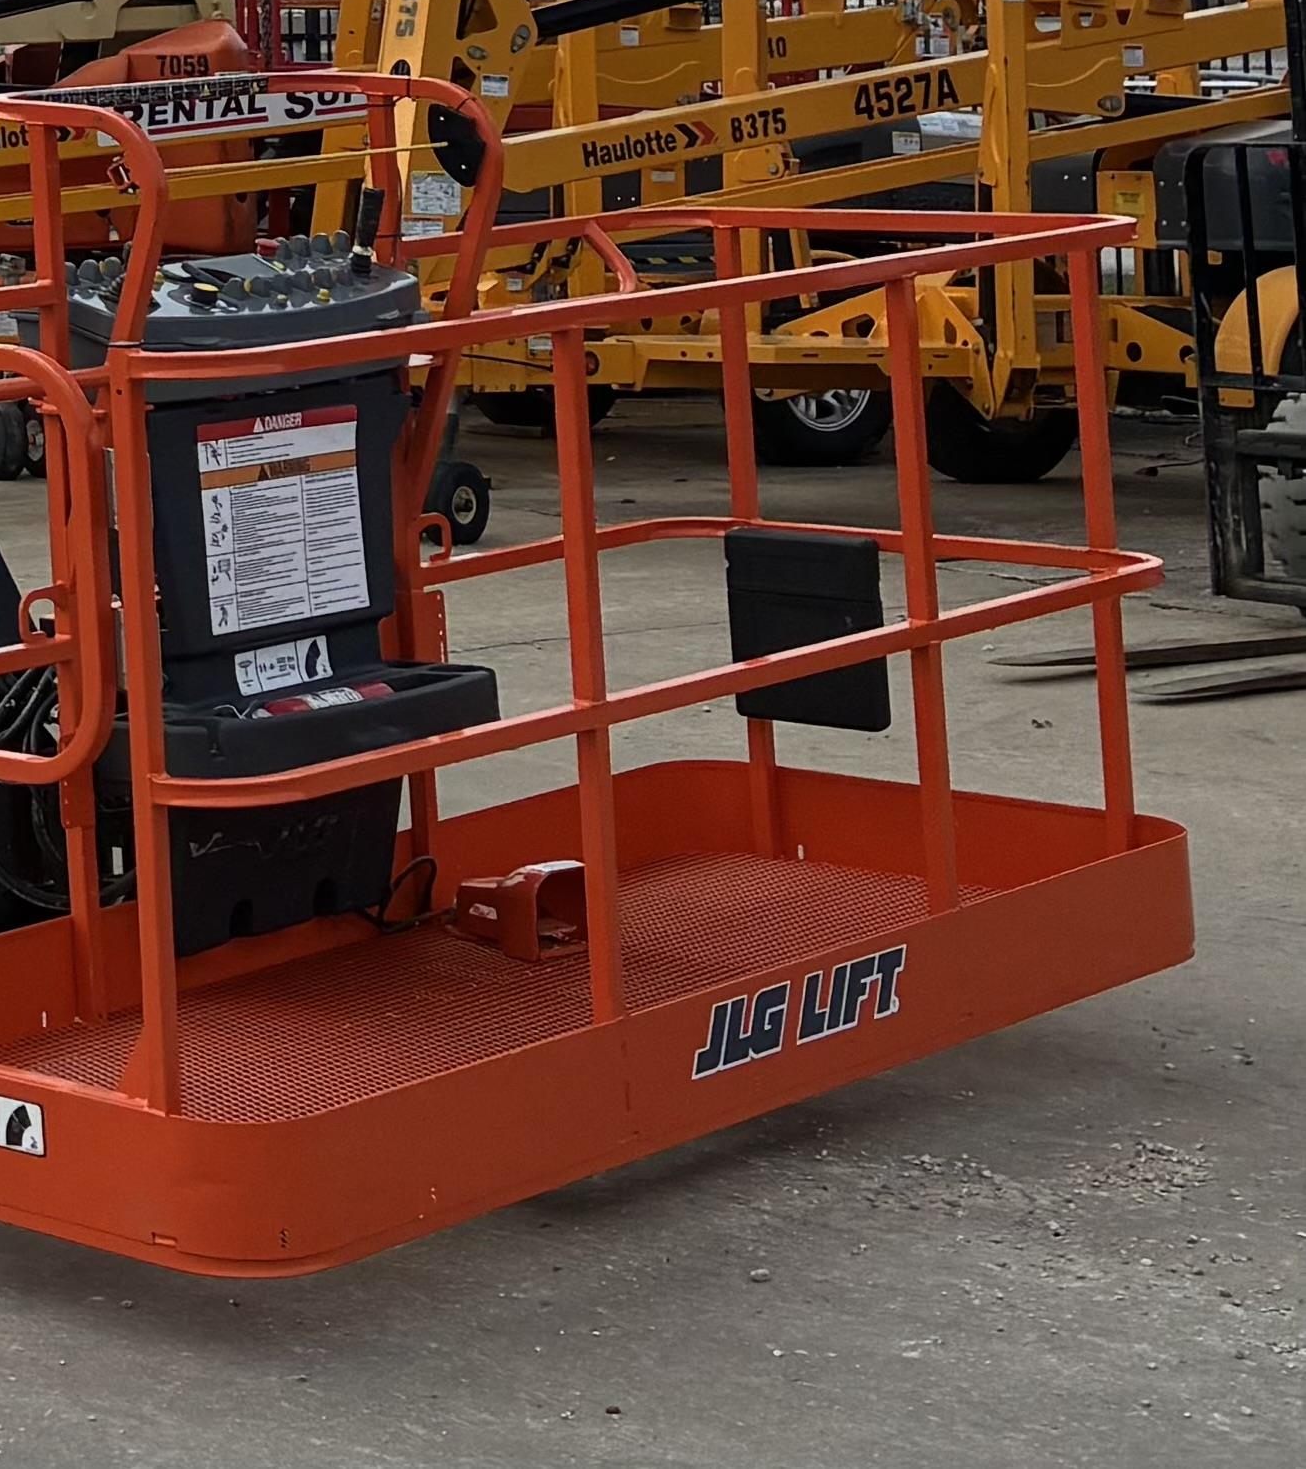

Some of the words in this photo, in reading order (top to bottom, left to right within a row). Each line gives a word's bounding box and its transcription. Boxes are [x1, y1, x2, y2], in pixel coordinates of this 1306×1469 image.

[157, 54, 210, 77] 7059
[854, 68, 960, 122] 4527A
[581, 131, 678, 169] Haulotte
[264, 412, 303, 431] DANGER
[691, 980, 791, 1080] JLG
[797, 944, 907, 1045] LIFT
